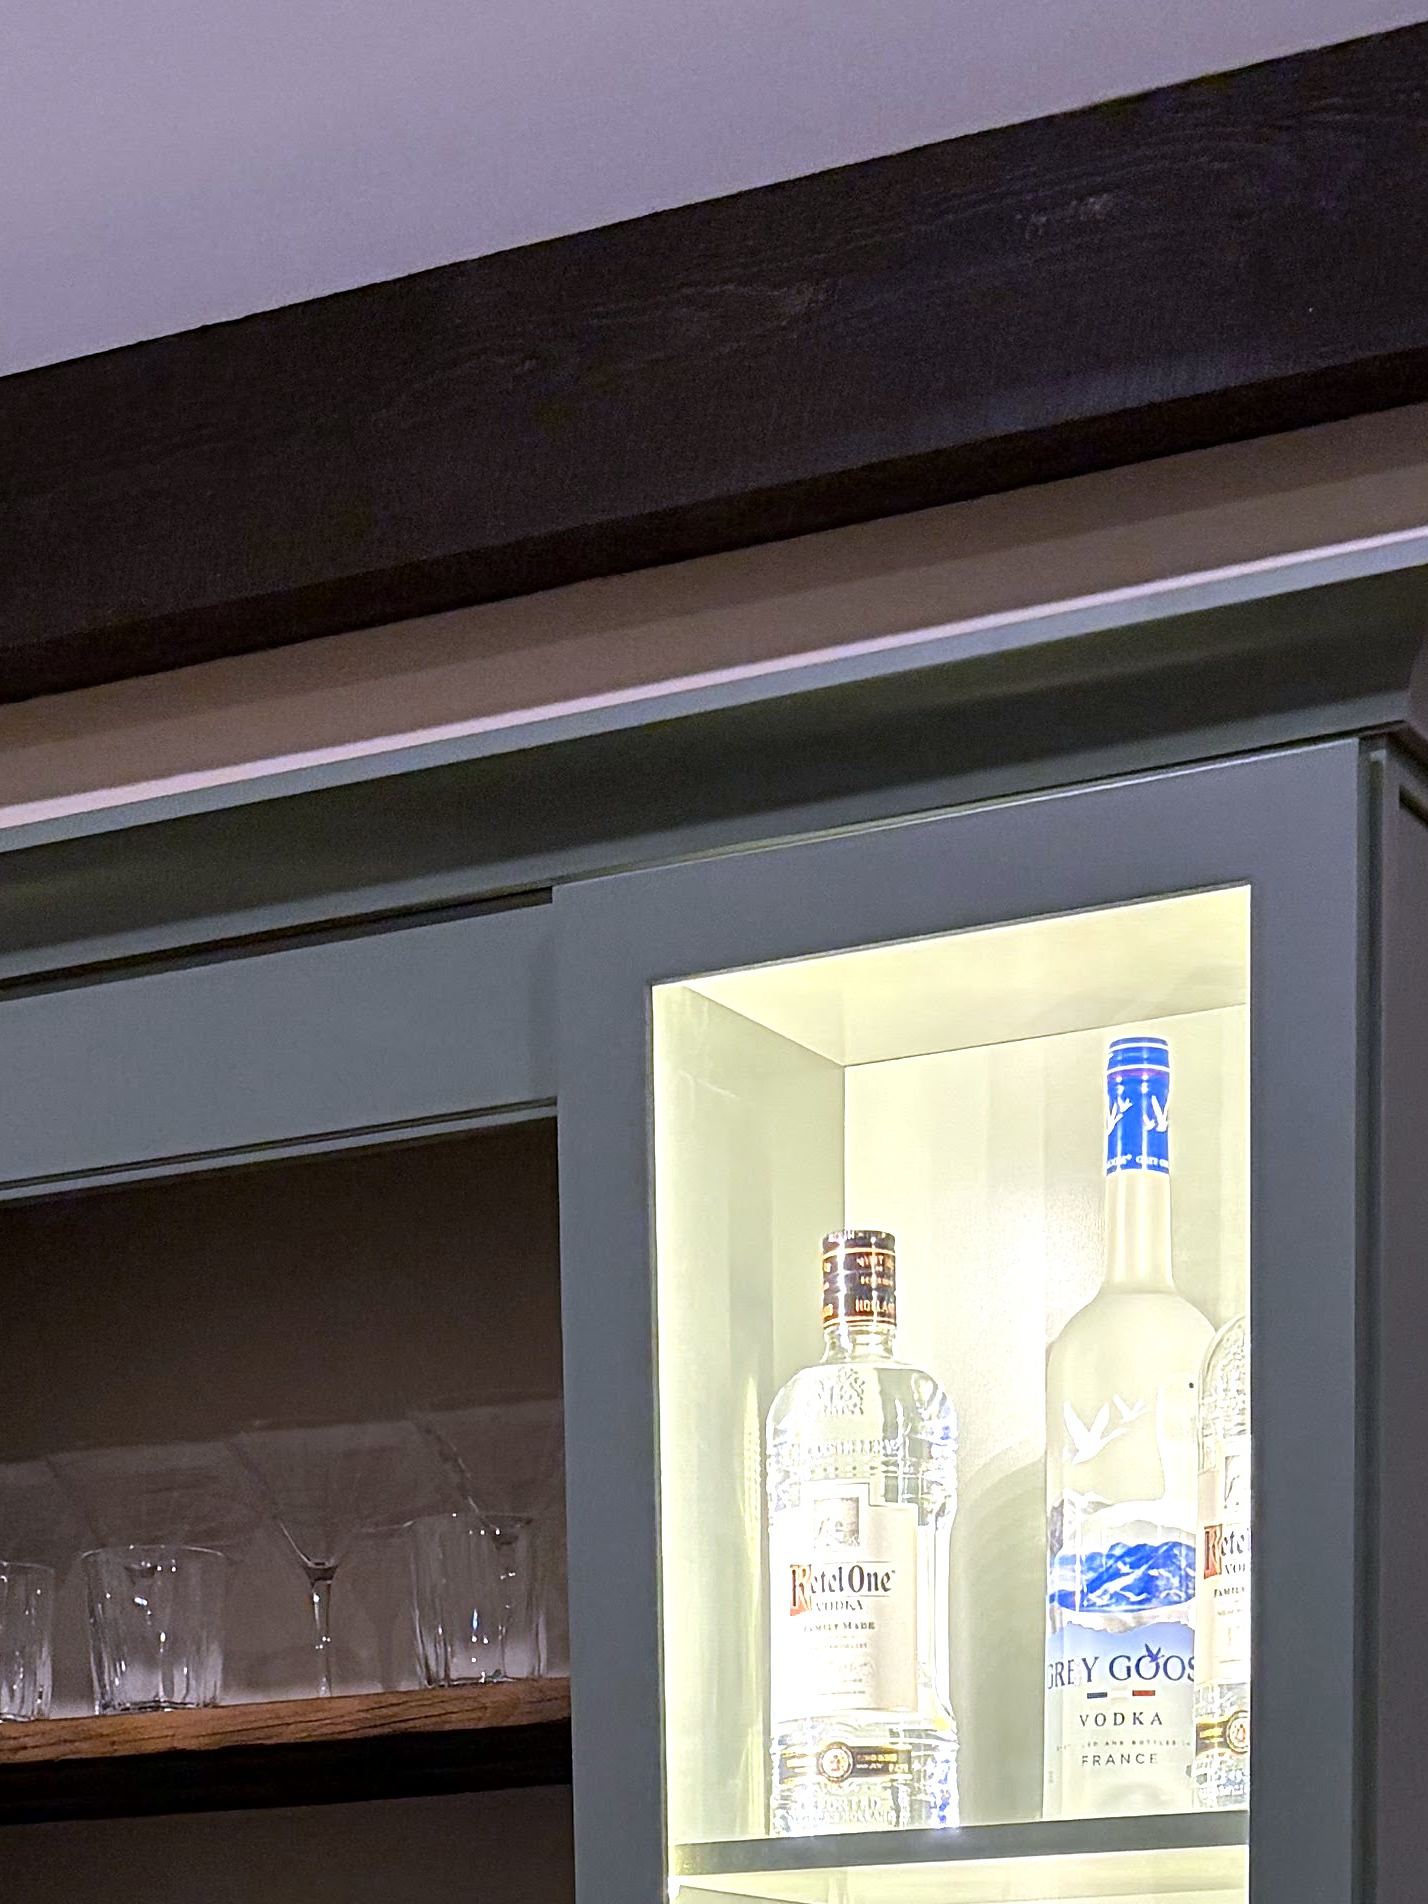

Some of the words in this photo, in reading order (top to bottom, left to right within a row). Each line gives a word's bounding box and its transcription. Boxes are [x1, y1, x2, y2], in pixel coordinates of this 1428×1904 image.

[790, 1564, 845, 1617] Ketel
[847, 1565, 893, 1594] One
[1047, 1656, 1099, 1690] GREY
[1108, 1654, 1195, 1683] GOOS
[1079, 1711, 1163, 1727] VODKA
[1081, 1752, 1159, 1767] FRANCE
